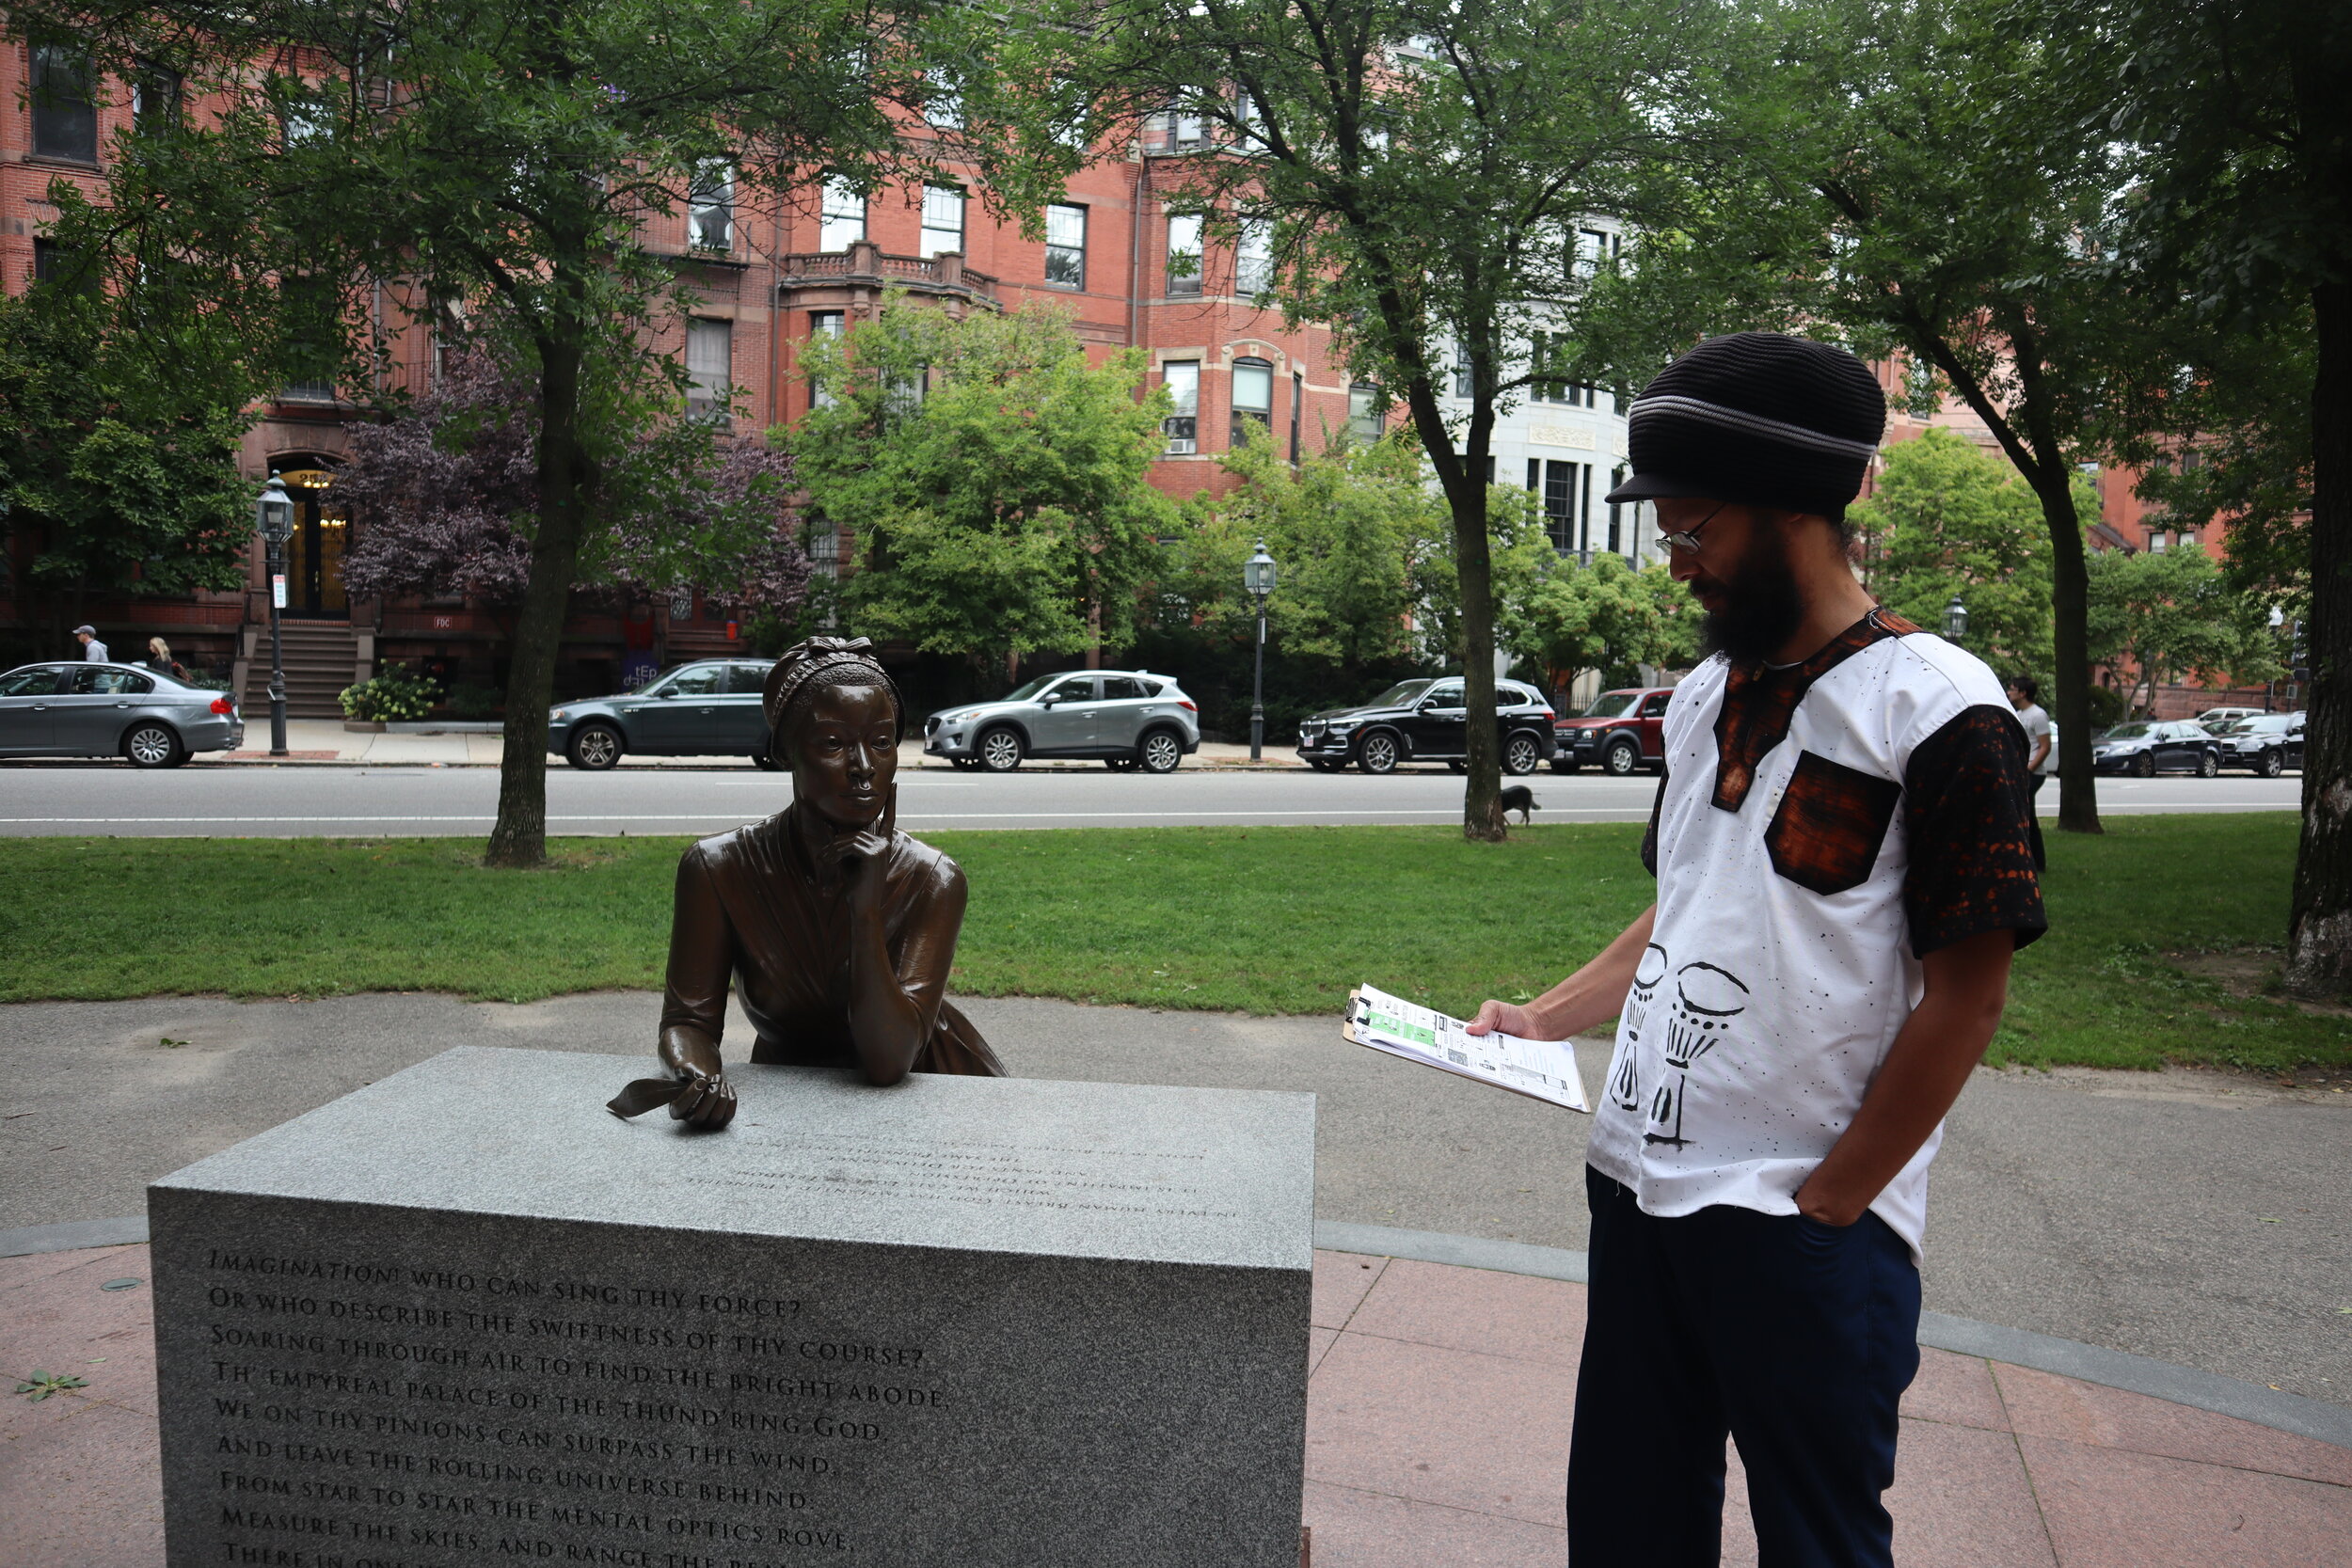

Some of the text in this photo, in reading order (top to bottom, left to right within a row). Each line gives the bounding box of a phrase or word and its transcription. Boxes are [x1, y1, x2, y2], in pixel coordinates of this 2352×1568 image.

[412, 1270, 474, 1292] WHO
[486, 1276, 540, 1296] CAN
[553, 1282, 618, 1305] SING
[631, 1289, 685, 1308] THY
[698, 1294, 801, 1319] FORCE?
[208, 1287, 922, 1369] OR WHO DESCRIBE THE SWIFTNESS OF THY COURSE?
[210, 1323, 949, 1411] SOARING THROUGH AIR TO FIND THE BRIGHT ABODE,
[215, 1397, 251, 1419] WE
[263, 1404, 301, 1423] ON
[313, 1410, 363, 1430] THY
[374, 1416, 486, 1442] PINIONS
[497, 1428, 551, 1448] CAN
[564, 1433, 673, 1459] SURPASS
[684, 1445, 735, 1466] THE
[269, 1370, 394, 1397] EMPYREAL
[407, 1383, 500, 1406] PALACE
[509, 1392, 542, 1410] OF
[555, 1395, 604, 1417] THE
[618, 1401, 801, 1434] THUND'RING
[216, 1435, 273, 1457] AND
[284, 1444, 357, 1466] LEAVE
[366, 1450, 415, 1473] THE
[428, 1457, 544, 1484] ROLLING
[556, 1470, 685, 1498] UNIVERSE
[220, 1471, 291, 1496] FROM
[302, 1481, 360, 1502] STAR
[371, 1487, 406, 1506] TO
[417, 1491, 477, 1515] STAR
[486, 1498, 539, 1521] THE
[552, 1507, 654, 1532] MENTAL
[666, 1518, 765, 1544] OPTICS
[221, 1507, 339, 1535] MEASURE
[350, 1522, 397, 1542] THE
[498, 1537, 553, 1558] AND
[566, 1544, 650, 1568] RANGE
[224, 1543, 302, 1568] THERE
